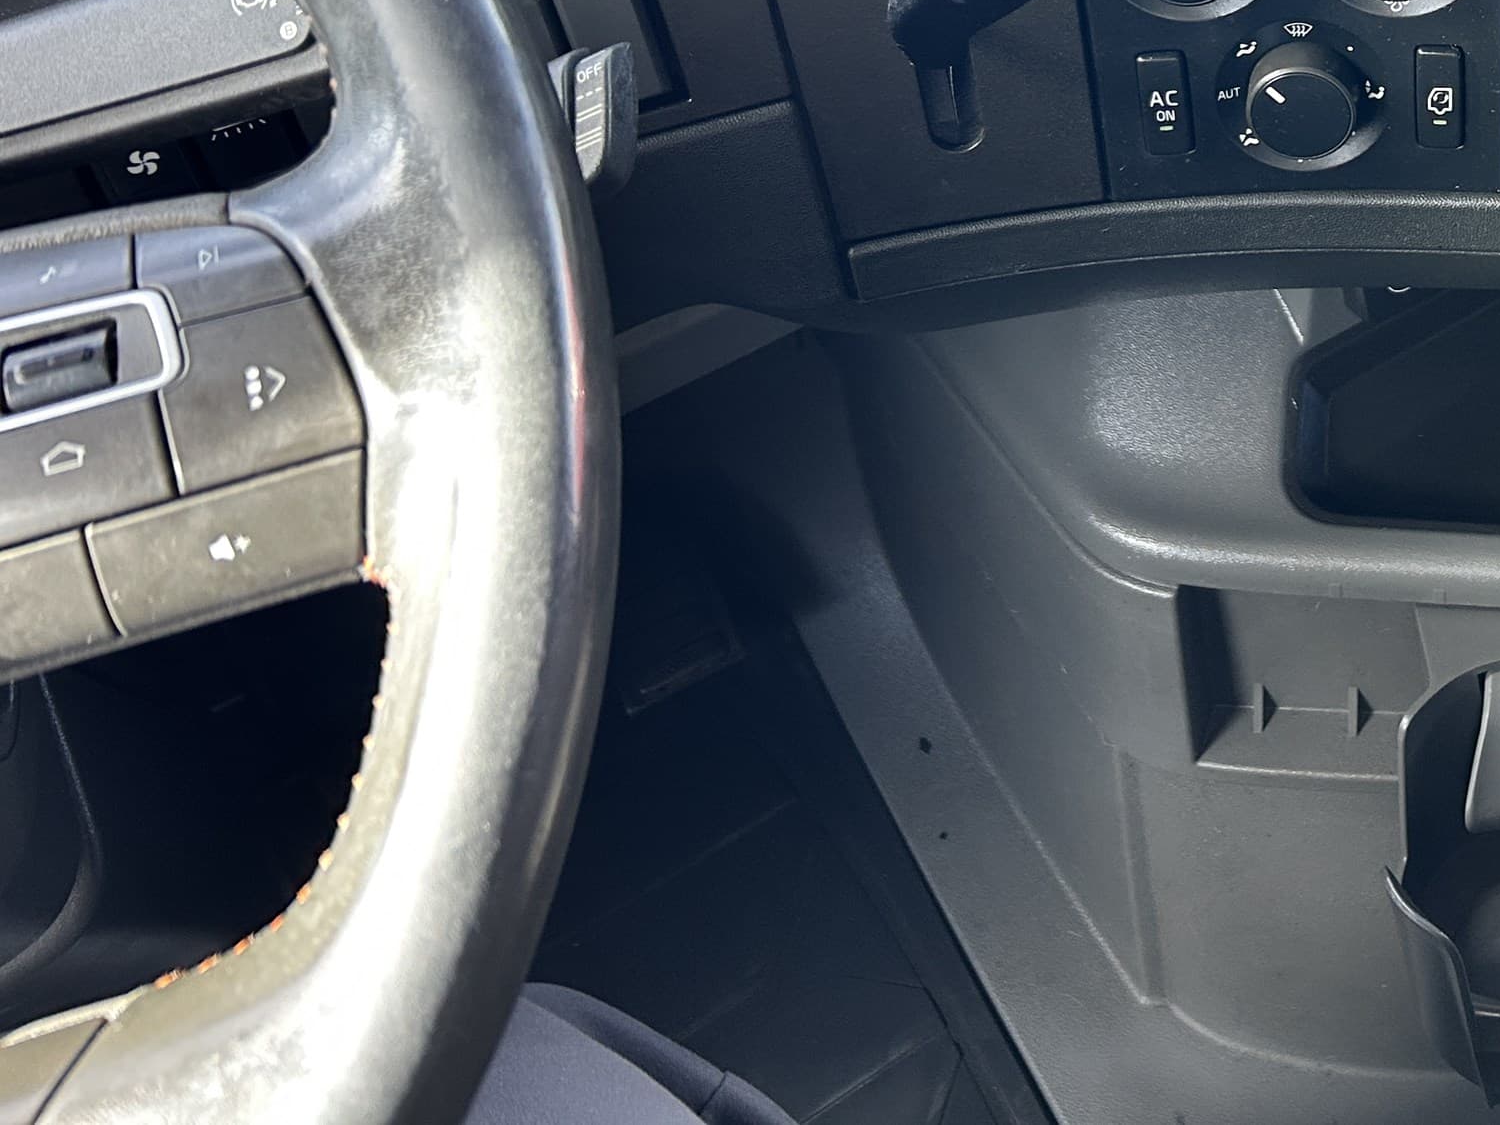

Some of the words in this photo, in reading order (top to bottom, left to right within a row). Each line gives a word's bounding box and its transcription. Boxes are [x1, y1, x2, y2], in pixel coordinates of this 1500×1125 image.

[577, 62, 603, 83] OFF
[1150, 89, 1179, 108] AC
[1217, 86, 1241, 102] AUT
[1156, 109, 1176, 122] ON
